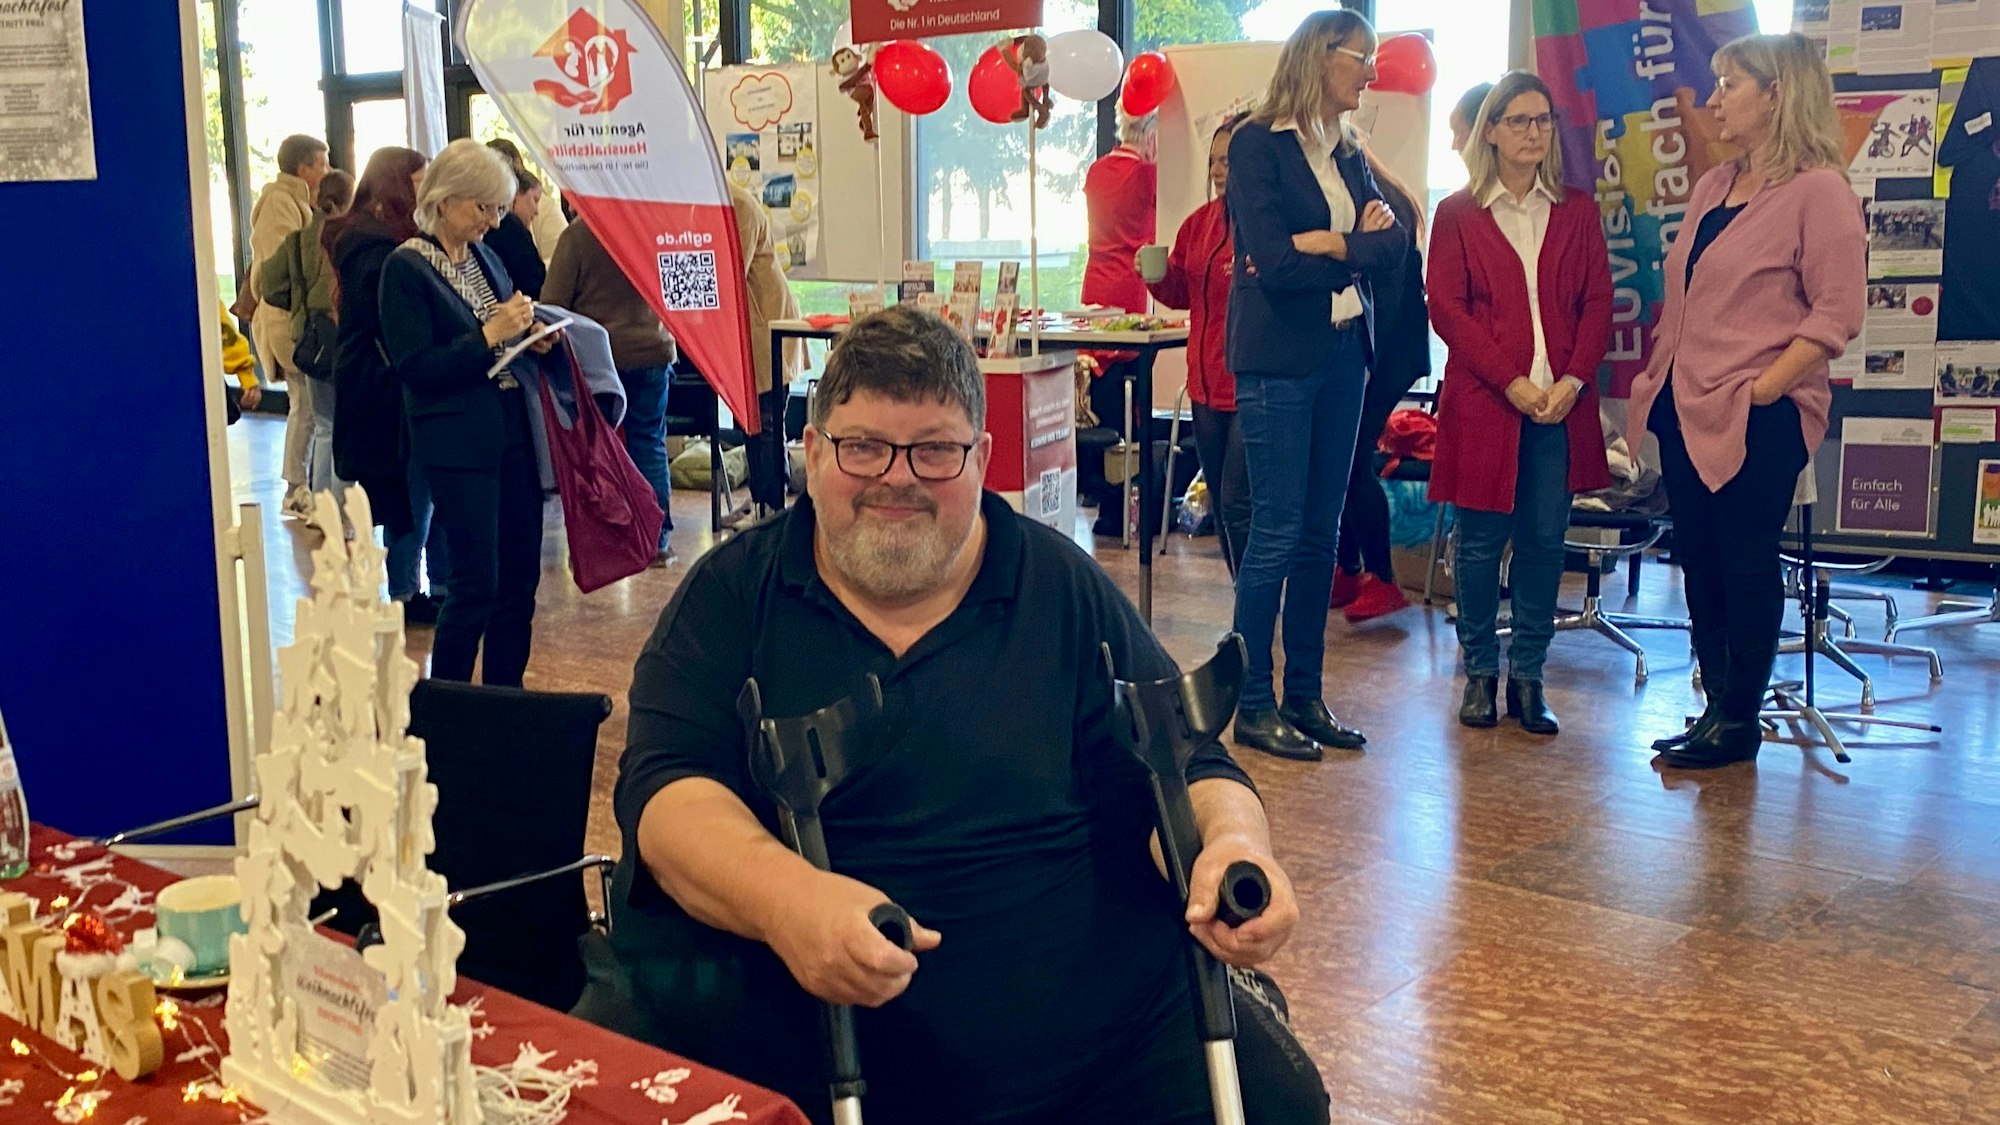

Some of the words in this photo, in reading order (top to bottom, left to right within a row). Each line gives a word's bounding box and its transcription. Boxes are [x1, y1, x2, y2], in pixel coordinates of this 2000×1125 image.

[890, 19, 905, 30] Die
[907, 18, 920, 29] Nr.
[921, 16, 925, 27] 1
[927, 16, 936, 26] in
[938, 9, 1000, 26] Deutschland
[1632, 0, 1675, 81] für
[1852, 477, 1903, 491] Einfach
[1851, 497, 1871, 510] für
[1873, 497, 1901, 511] Alle
[0, 892, 164, 1081] MAS
